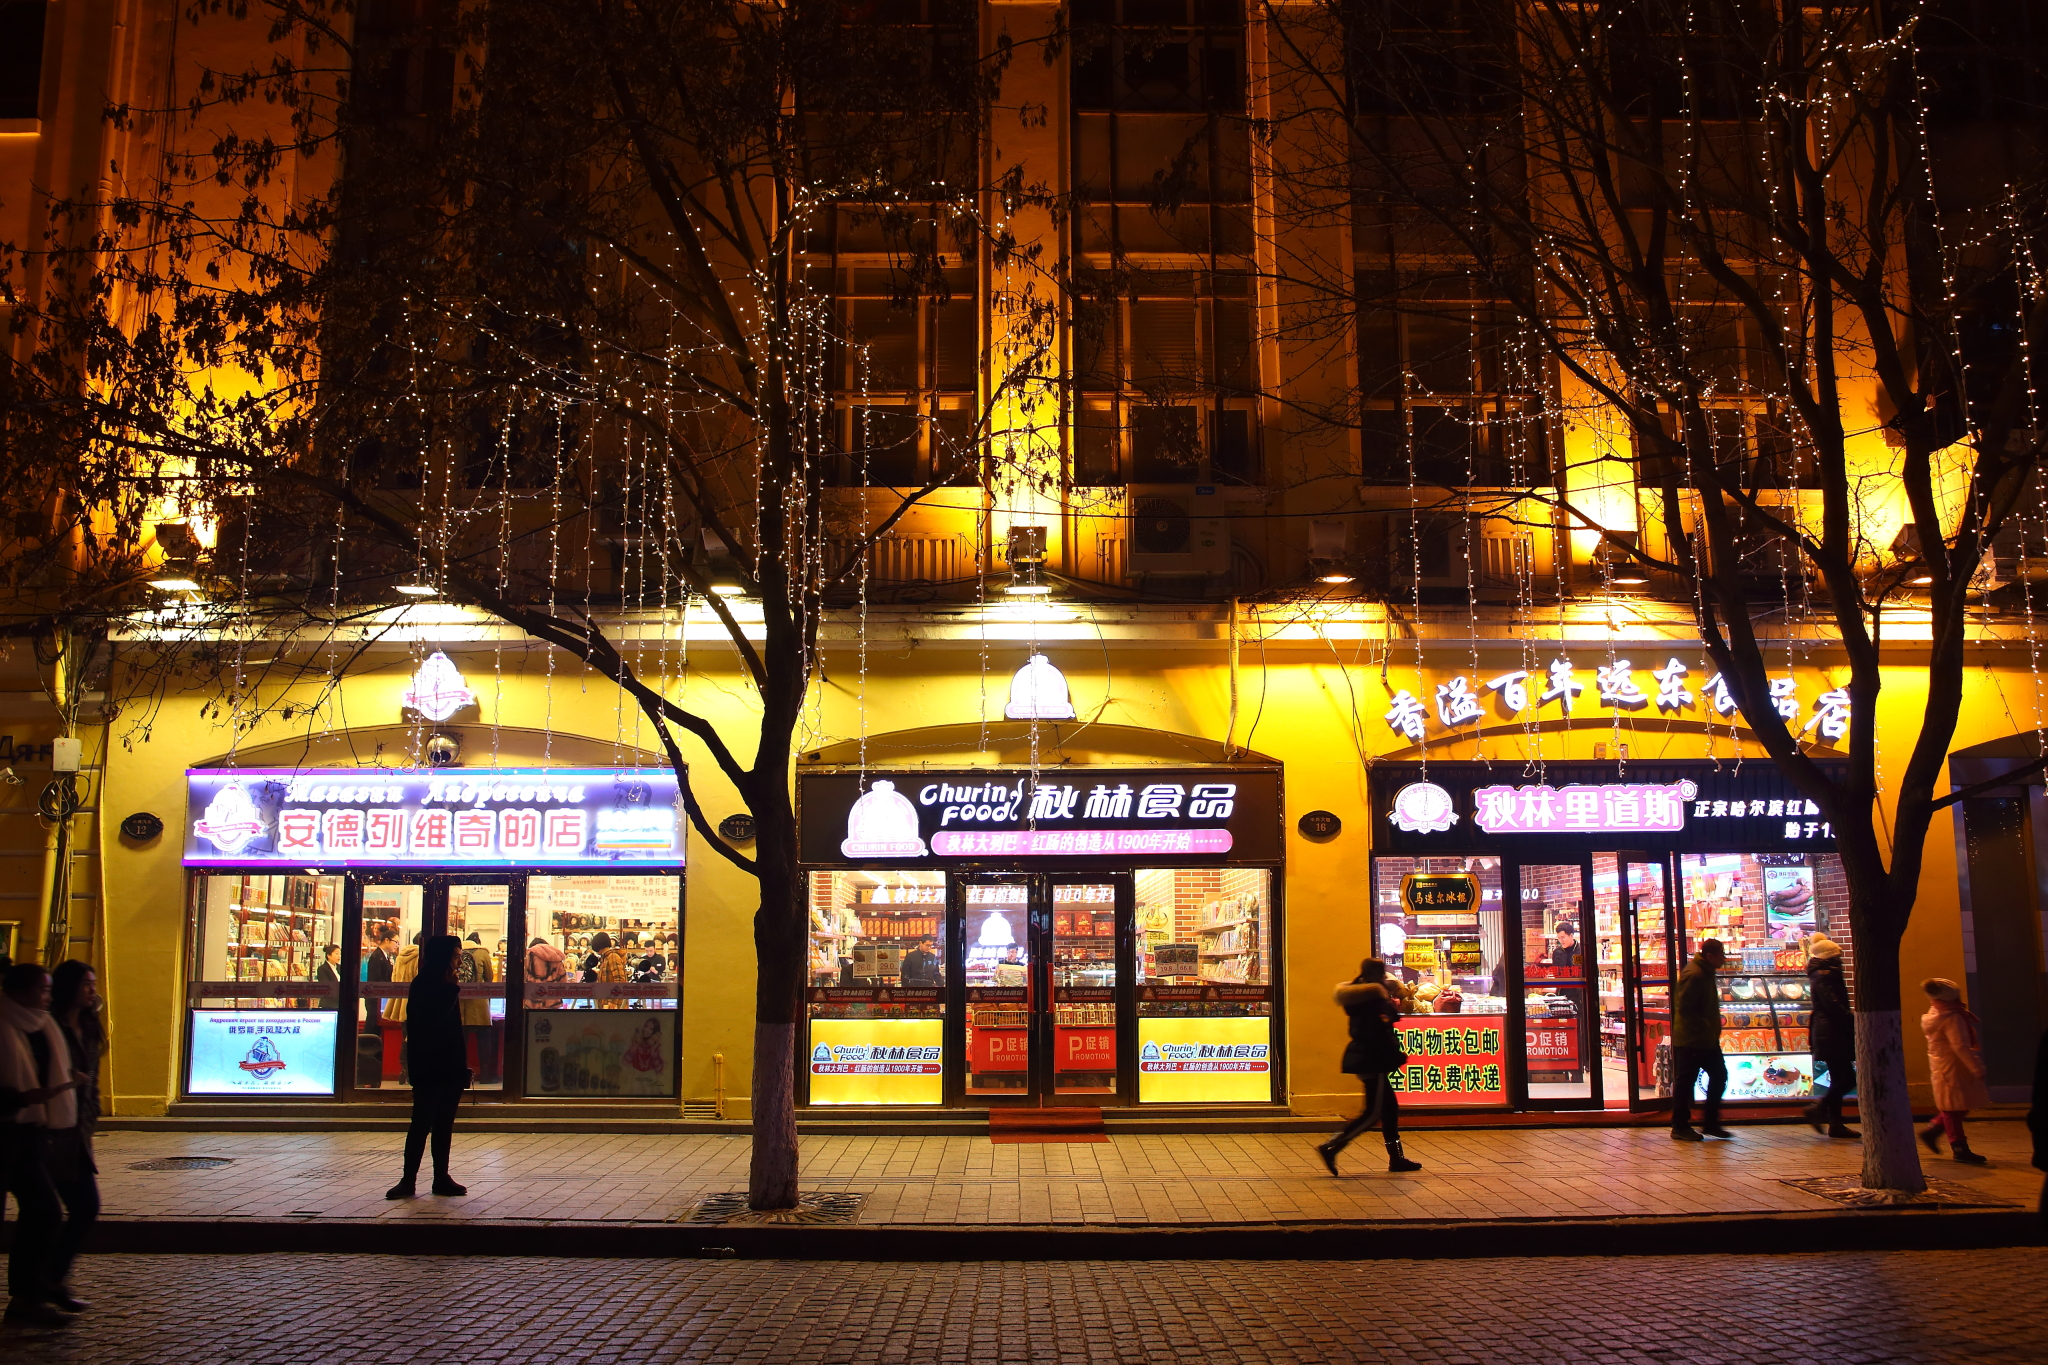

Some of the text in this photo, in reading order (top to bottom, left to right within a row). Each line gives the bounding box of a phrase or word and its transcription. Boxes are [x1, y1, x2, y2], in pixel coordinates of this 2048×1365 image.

[919, 782, 1008, 806] Churin
[1027, 783, 1237, 819] 秋林食品
[136, 825, 147, 835] 12
[281, 811, 584, 850] 安德列维奇的店
[735, 827, 745, 836] 14
[1316, 823, 1327, 832] 16
[1784, 821, 1836, 839] 始于1
[851, 843, 915, 852] CHURIN FOOD
[1415, 891, 1467, 905] 马迭尔冰棍
[857, 963, 871, 971] 26.0
[880, 962, 894, 970] 29.0
[1086, 1036, 1110, 1050] 促销
[1539, 1032, 1568, 1046] 促销
[870, 1046, 941, 1060] 秋林食品
[1198, 1044, 1268, 1058] 秋林食品
[1387, 1064, 1501, 1093] 全国免费快递
